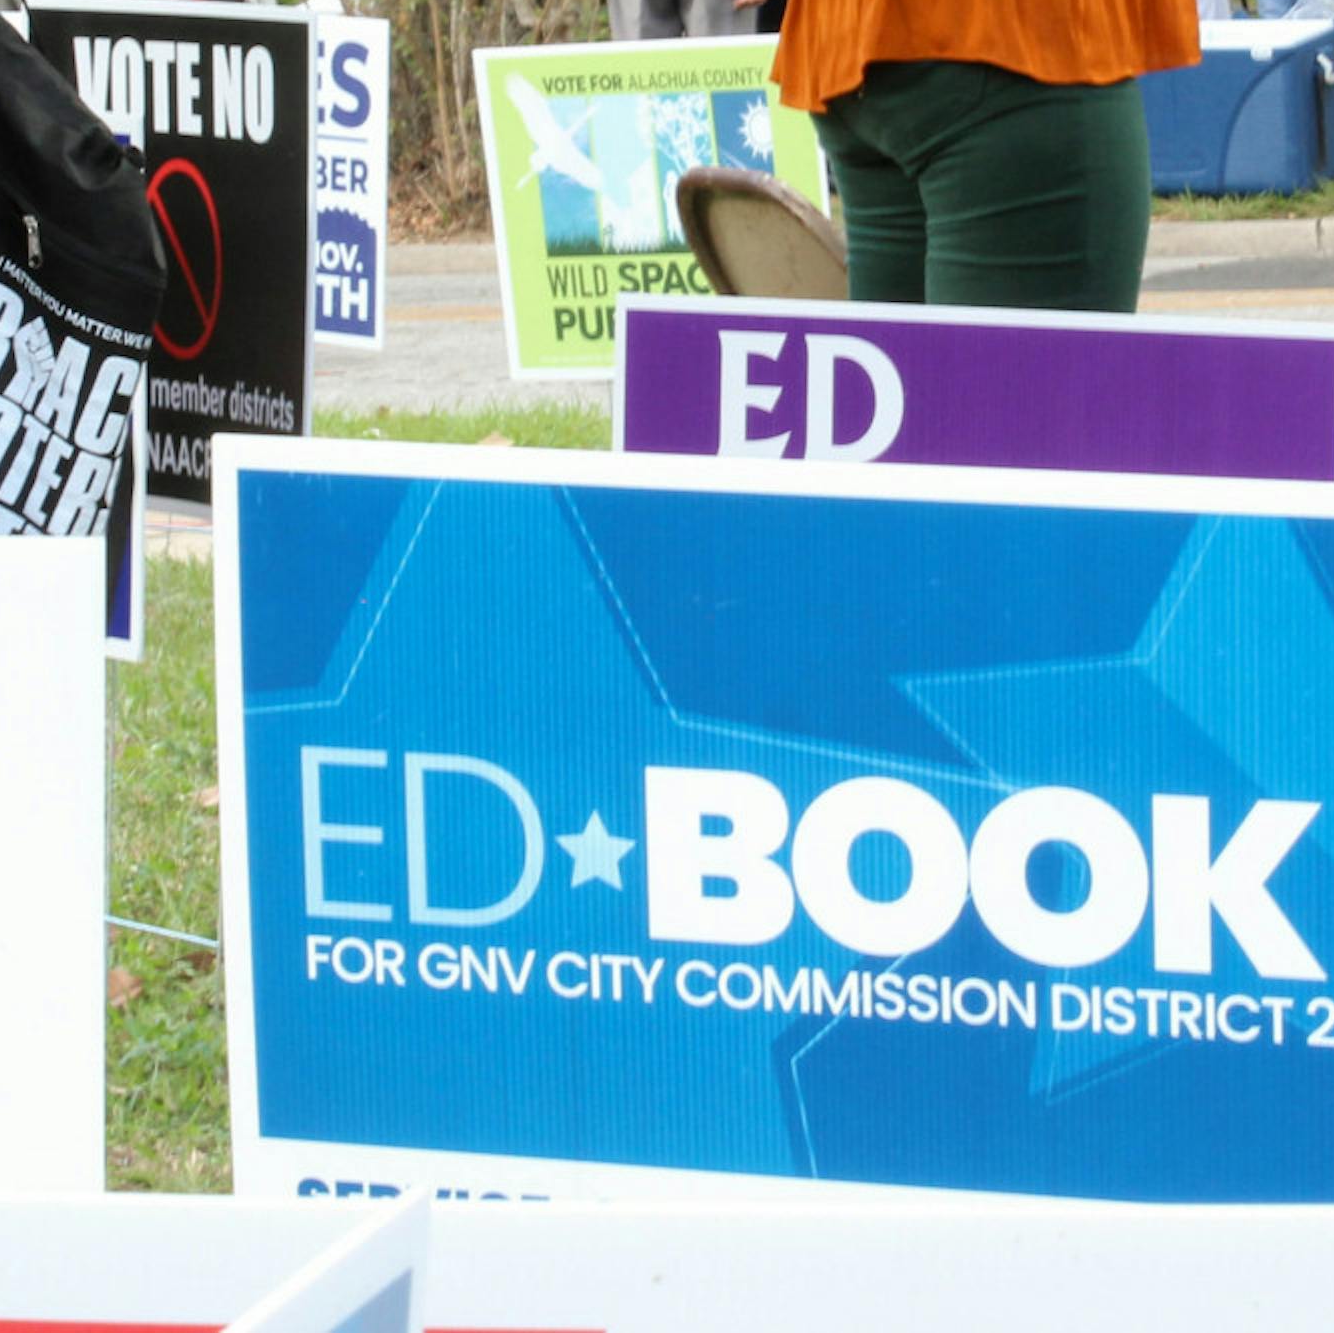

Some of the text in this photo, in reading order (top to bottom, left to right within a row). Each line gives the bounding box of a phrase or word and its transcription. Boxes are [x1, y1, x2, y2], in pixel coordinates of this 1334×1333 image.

[73, 36, 274, 144] VOTE NO
[543, 67, 765, 94] VOTE FOR ALACHUA COUNTY
[547, 264, 608, 299] WILD
[150, 374, 295, 431] member districts
[718, 330, 904, 462] ED
[299, 744, 1328, 983] ED BOOK
[305, 935, 405, 987] FOR
[418, 942, 537, 997] GNV
[546, 951, 664, 1004] CITY
[674, 958, 1035, 1029] COMMISSION
[1050, 984, 1291, 1046] DISTRICT
